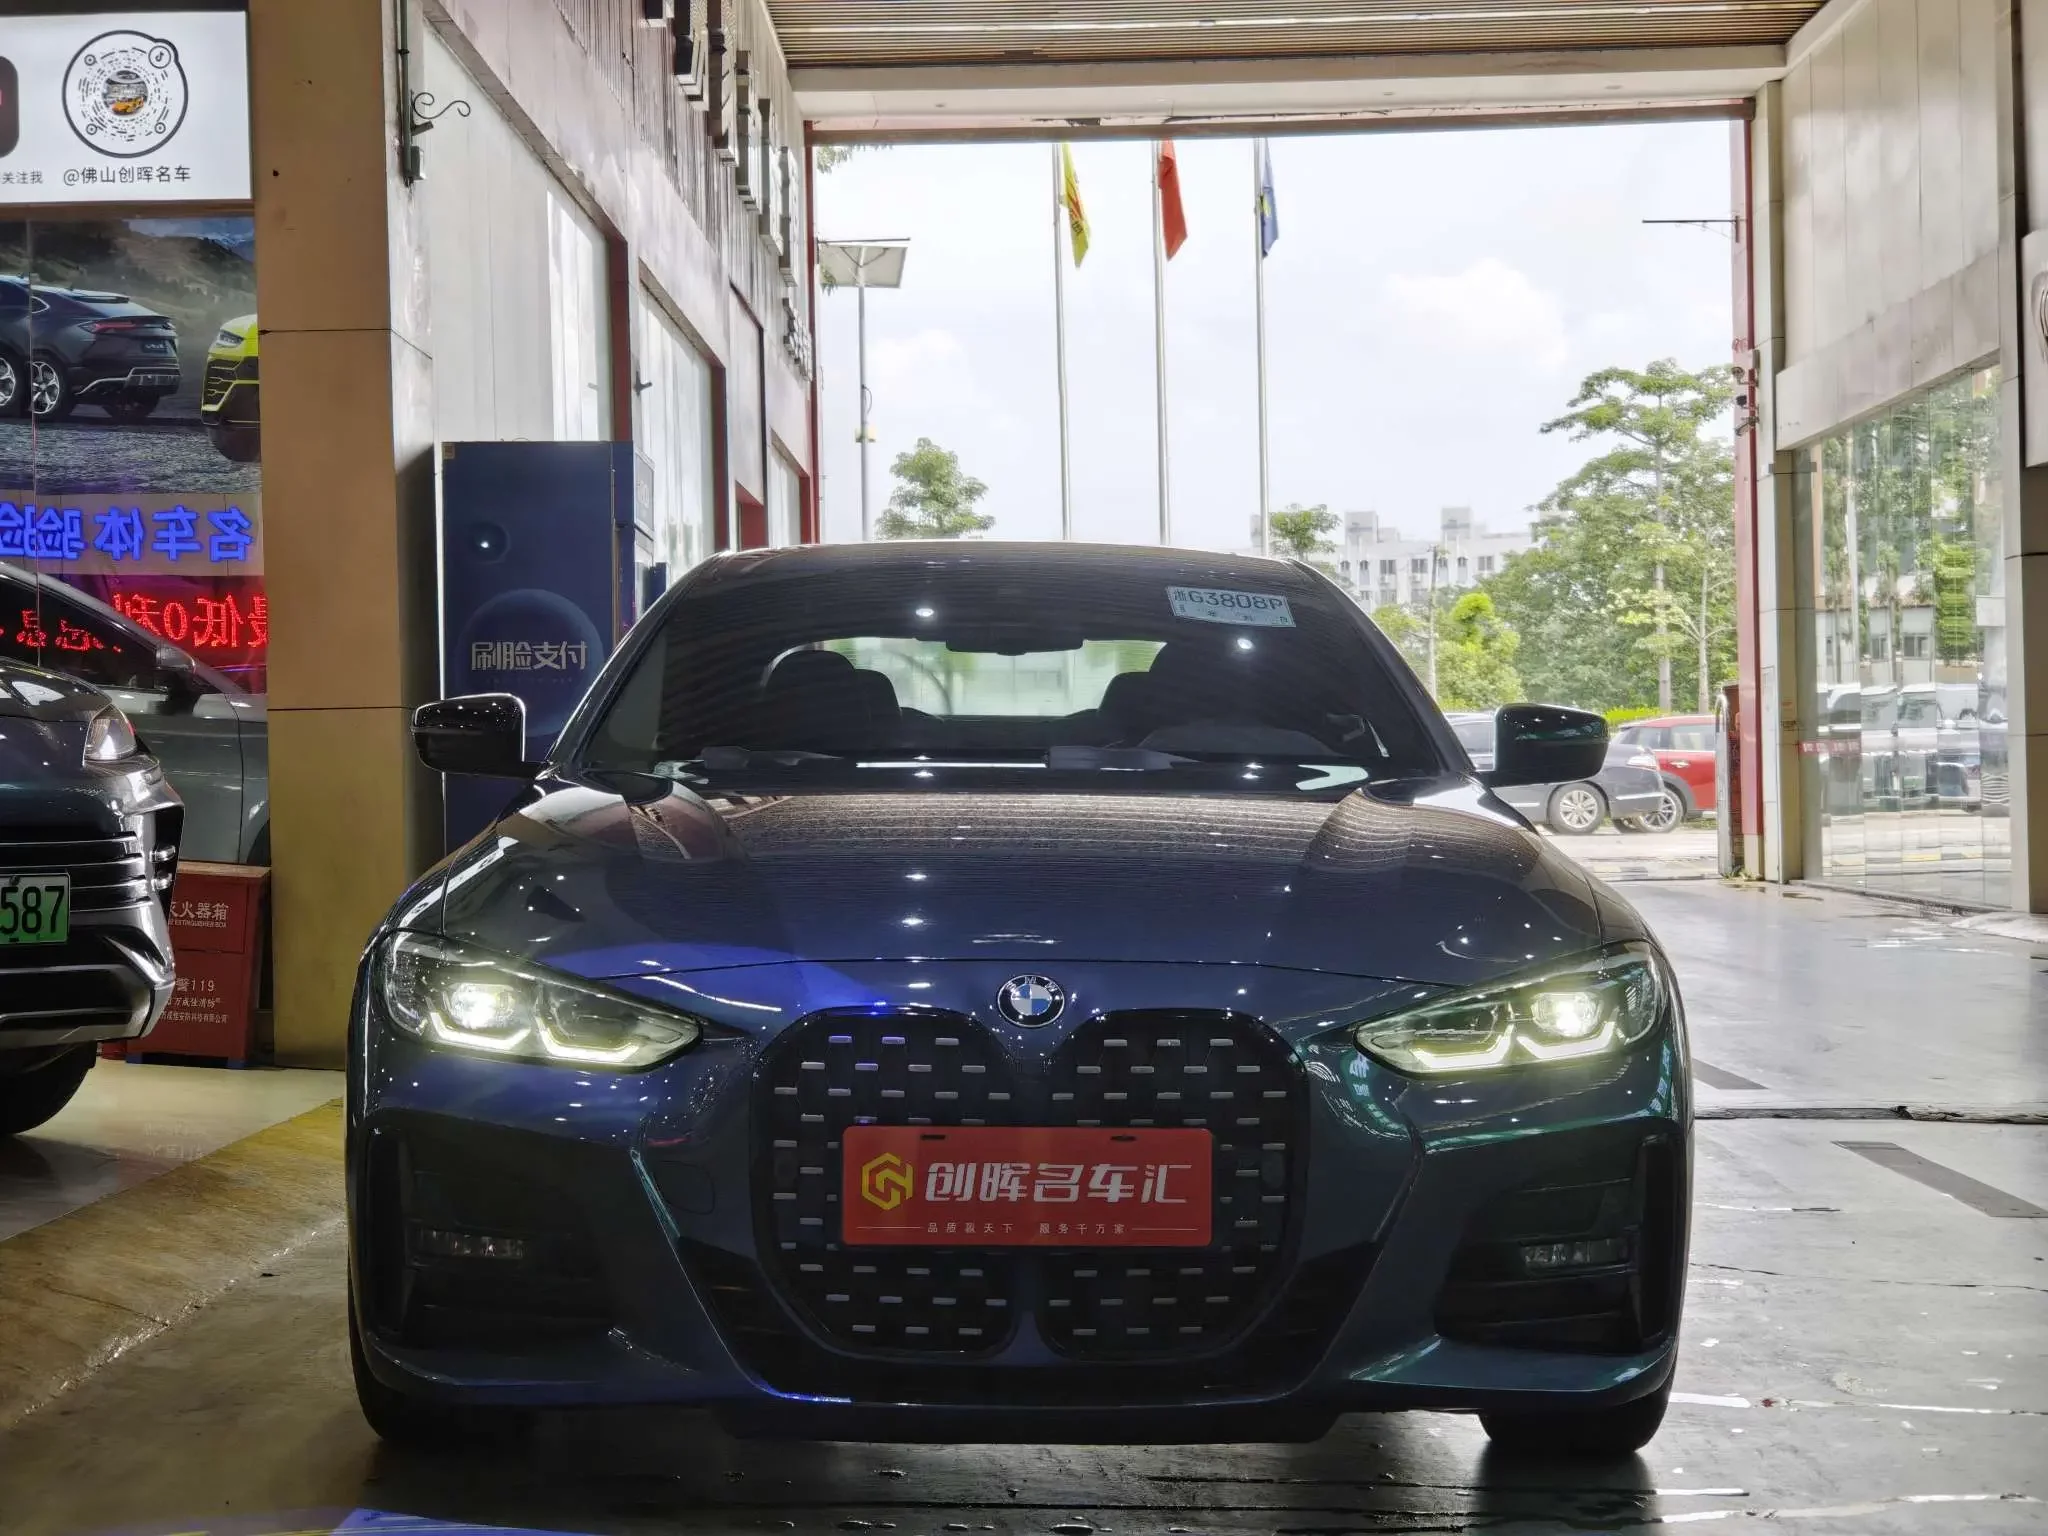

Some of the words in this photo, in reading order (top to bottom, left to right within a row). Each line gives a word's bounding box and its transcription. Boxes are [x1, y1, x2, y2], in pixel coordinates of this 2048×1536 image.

[2, 171, 43, 185] 关注我
[63, 165, 191, 187] @佛山创晖名车
[472, 641, 588, 671] 刷脸支付
[925, 1162, 1192, 1204] 创晖名车汇
[1039, 1223, 1125, 1235] 服务千万家
